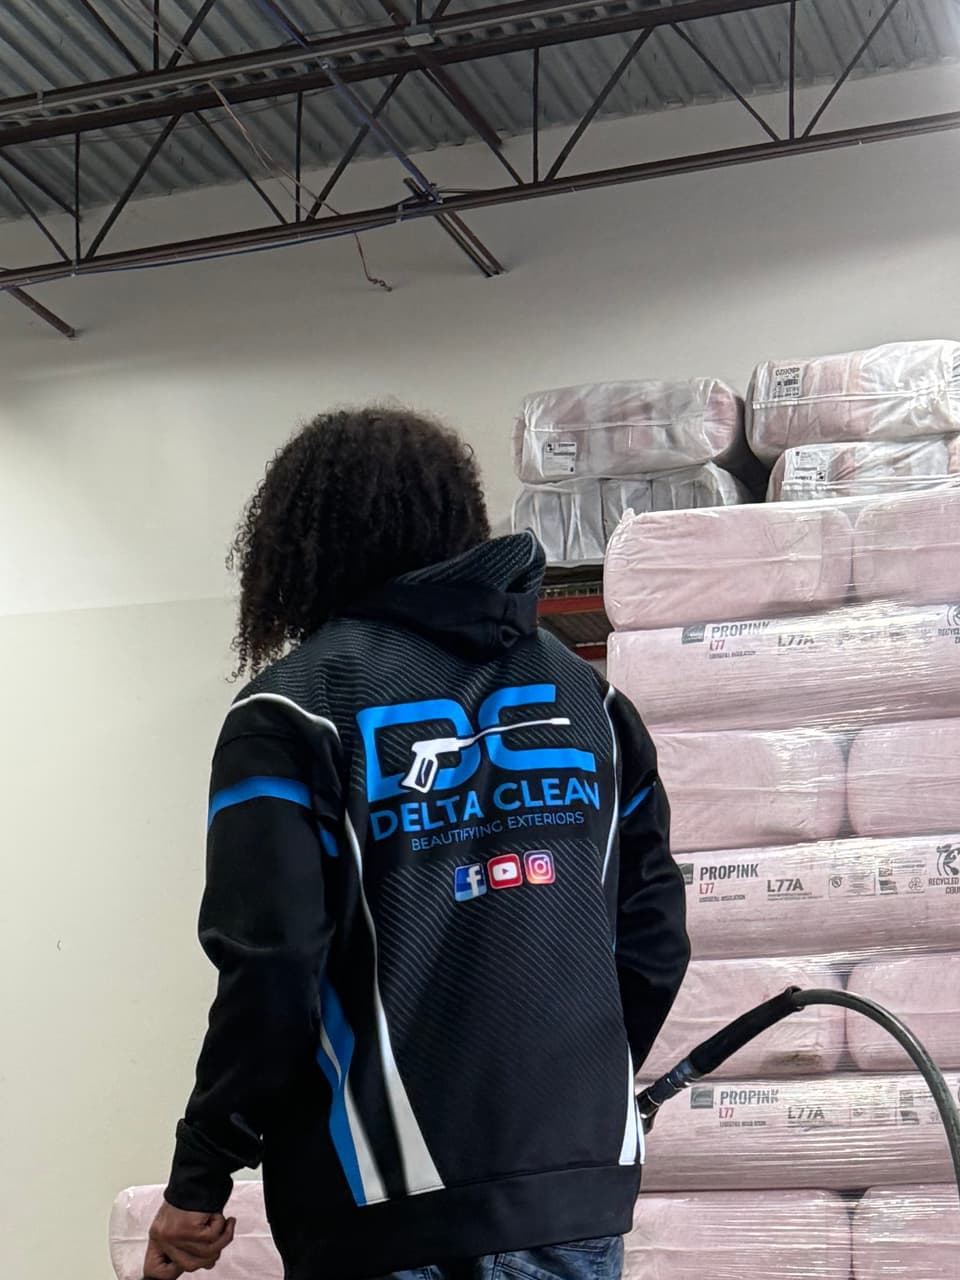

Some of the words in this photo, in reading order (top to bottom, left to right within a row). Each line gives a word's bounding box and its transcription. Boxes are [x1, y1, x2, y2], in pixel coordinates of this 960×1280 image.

[356, 684, 596, 803] DC
[369, 790, 484, 841] DELTA
[493, 777, 600, 811] CLEAN
[410, 821, 503, 851] BEAUTIFYING
[507, 811, 585, 829] EXTERIORS
[700, 863, 759, 880] PROPINK
[699, 882, 715, 894] L77
[767, 878, 804, 893] L77A
[720, 1089, 779, 1105] PROPINK
[719, 1107, 734, 1118] L77
[787, 1106, 825, 1119] L77A
